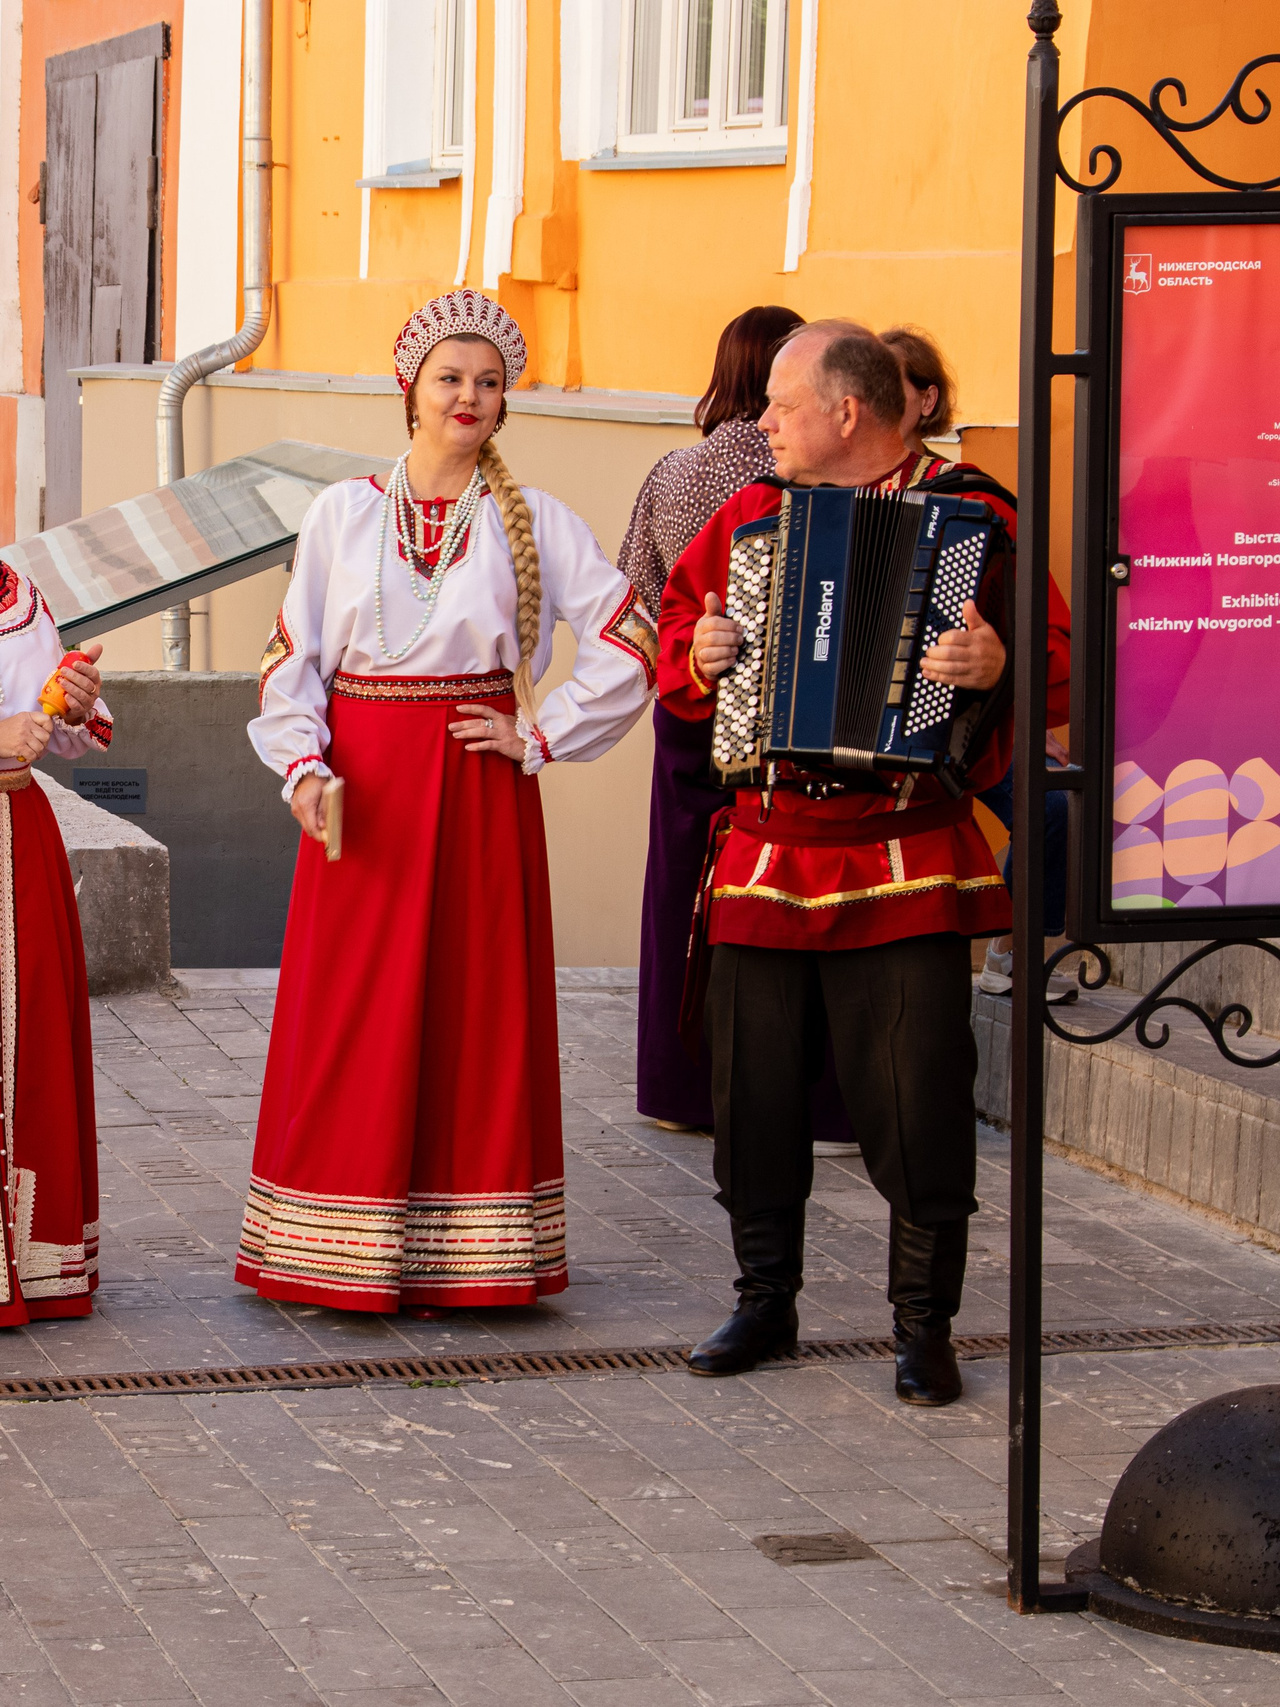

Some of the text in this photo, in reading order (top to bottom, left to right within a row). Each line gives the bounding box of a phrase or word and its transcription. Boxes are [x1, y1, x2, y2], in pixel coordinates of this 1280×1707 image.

[1158, 260, 1262, 272] НИЖЕГОРОДСКАЯ
[1158, 276, 1214, 287] ОБЛАСТЬ
[1234, 532, 1280, 545] Выста
[1133, 553, 1213, 568] «Нижний
[1221, 593, 1280, 609] Exhibiti
[815, 580, 835, 638] Roland
[1128, 614, 1272, 634] «Nizhny Novgorod
